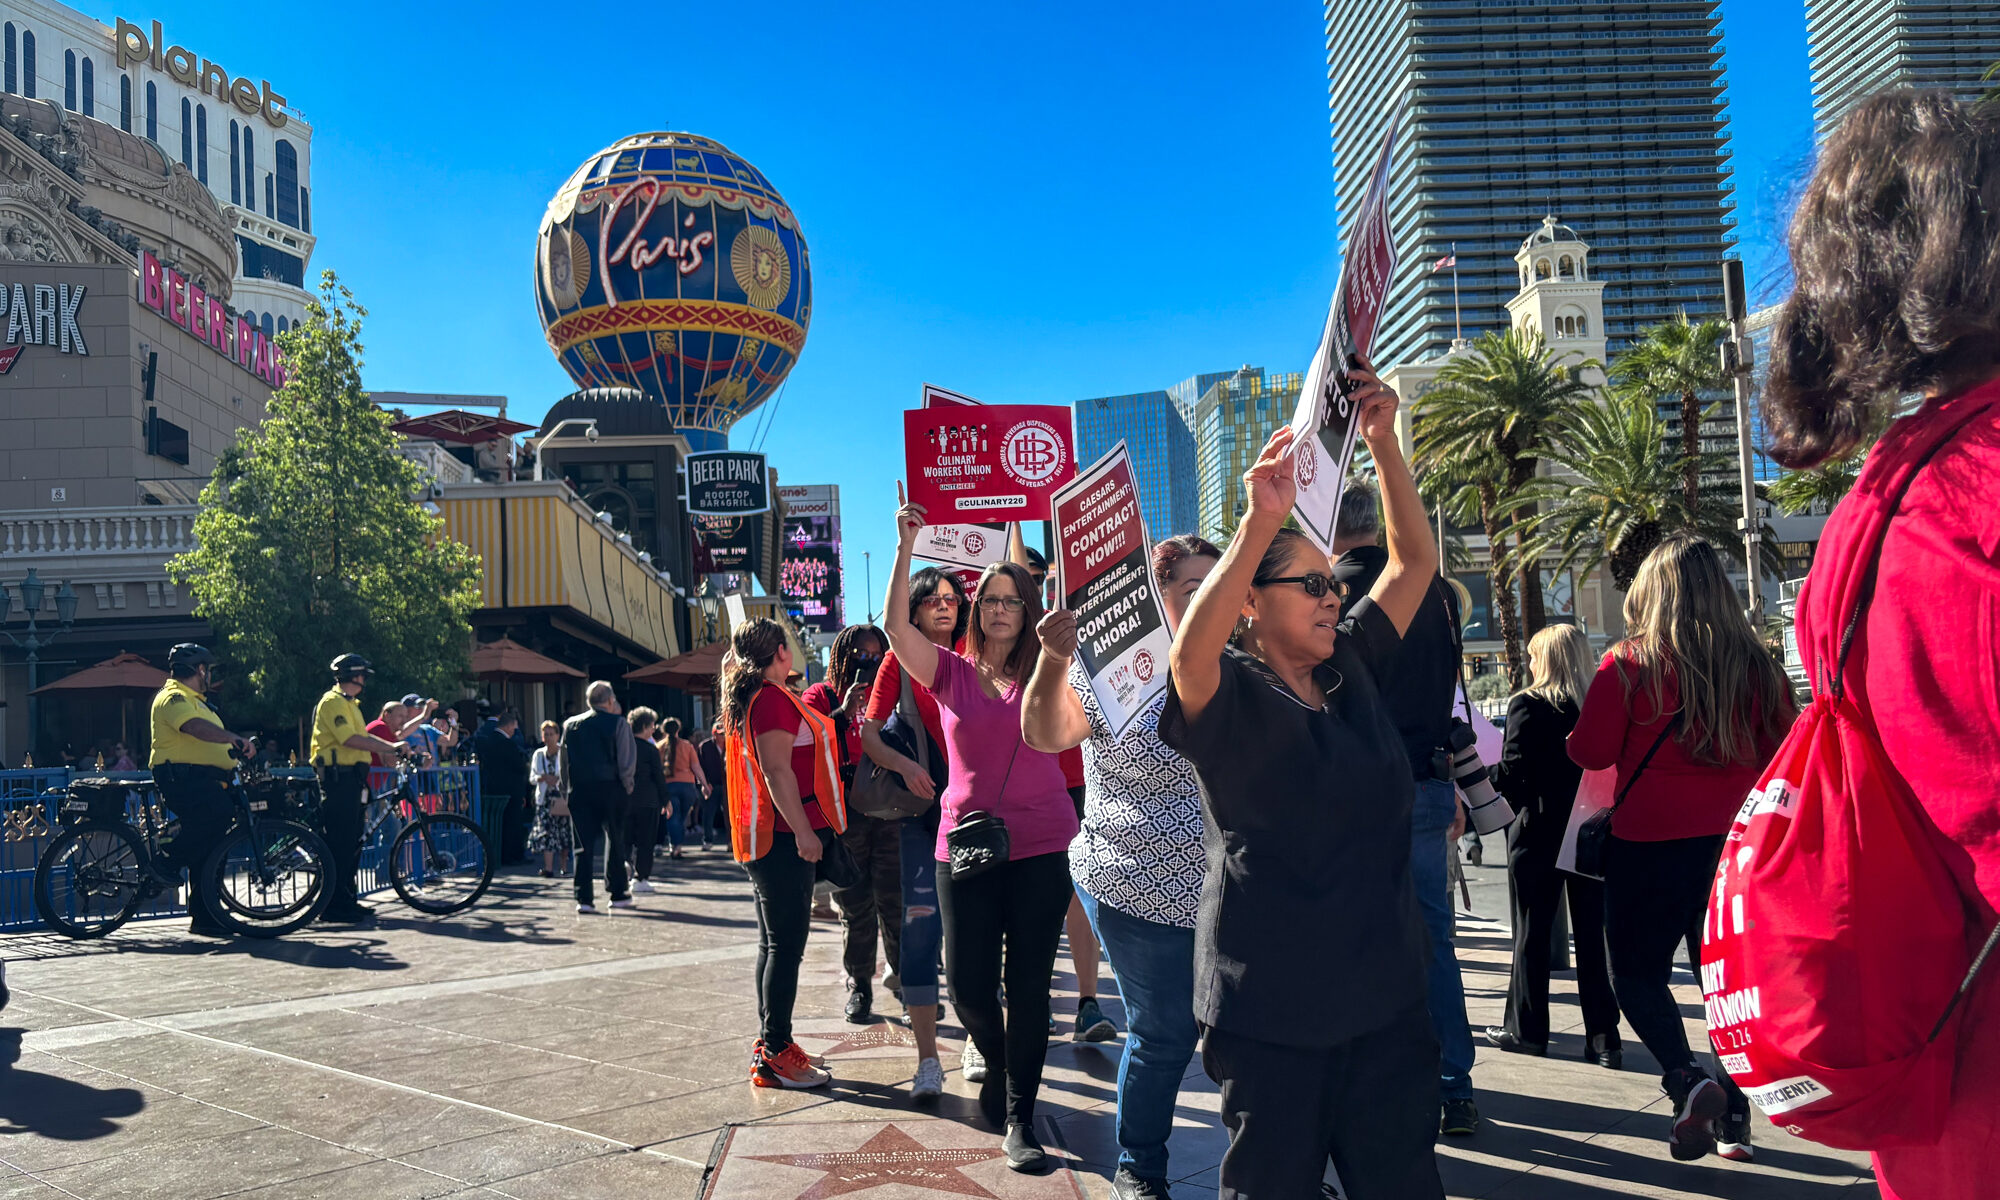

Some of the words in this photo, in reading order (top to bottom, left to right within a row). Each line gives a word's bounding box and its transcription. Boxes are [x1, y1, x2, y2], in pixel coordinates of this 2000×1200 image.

[116, 17, 288, 128] planet
[600, 176, 712, 308] Paris
[144, 251, 229, 355] BEER
[238, 317, 288, 389] PAR
[692, 459, 724, 485] BEER
[727, 459, 760, 484] PARK
[923, 466, 962, 478] WORKERS
[964, 465, 991, 475] UNION
[937, 454, 976, 466] CULINARY
[704, 490, 750, 500] ROOFTOP
[780, 488, 808, 497] anet
[1015, 476, 1025, 486] LAS
[1046, 476, 1054, 485] NV
[1080, 479, 1115, 512] CAESARS
[957, 497, 1024, 508] @CULINARY226
[1063, 483, 1131, 538] ENTERTAINMENT:
[1070, 500, 1135, 558] CONTRACT
[1085, 530, 1126, 571] NOW!!!
[1087, 563, 1128, 597] CAESARS
[1076, 584, 1148, 644] CONTRATO
[1093, 611, 1142, 658] AHORA!
[1710, 986, 1760, 1029] UNION
[1728, 1027, 1752, 1049] 226
[1763, 1080, 1819, 1106] SUFICIENTE
[886, 1167, 947, 1178] Vegas
